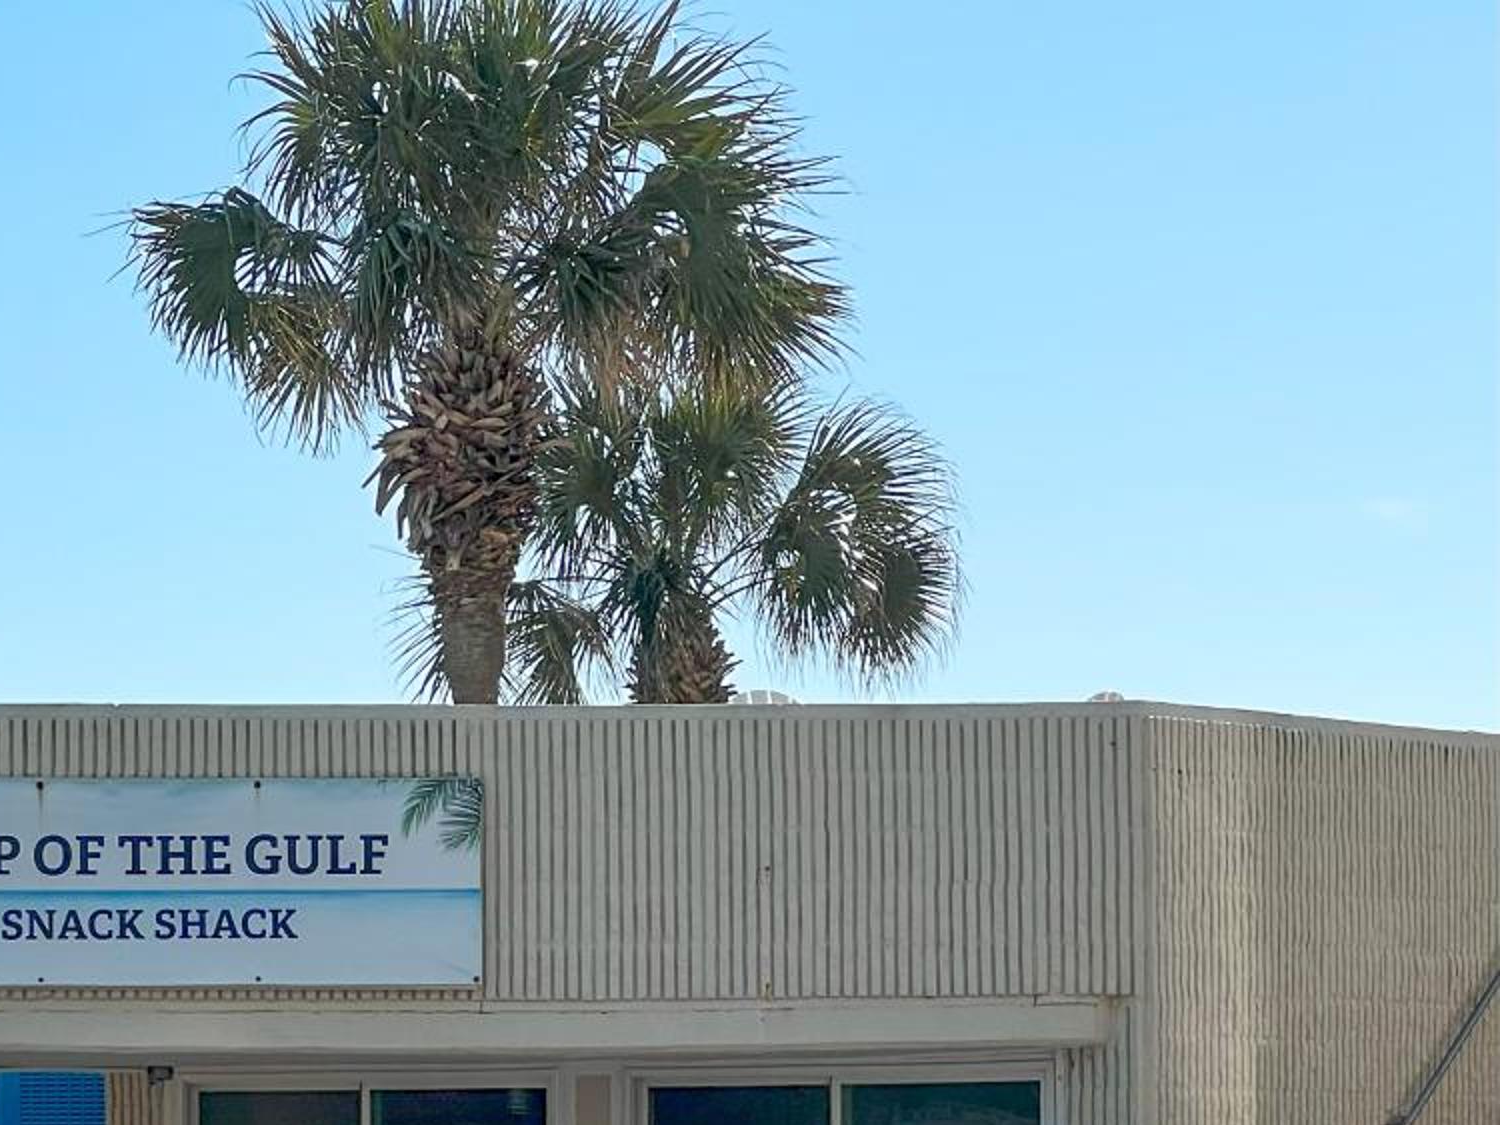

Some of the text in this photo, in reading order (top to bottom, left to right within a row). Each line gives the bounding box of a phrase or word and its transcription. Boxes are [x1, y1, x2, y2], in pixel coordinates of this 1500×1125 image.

[33, 835, 104, 876] OF
[118, 835, 231, 875] THE
[244, 834, 389, 876] GULF
[1, 908, 298, 940] SNACK SHACK
